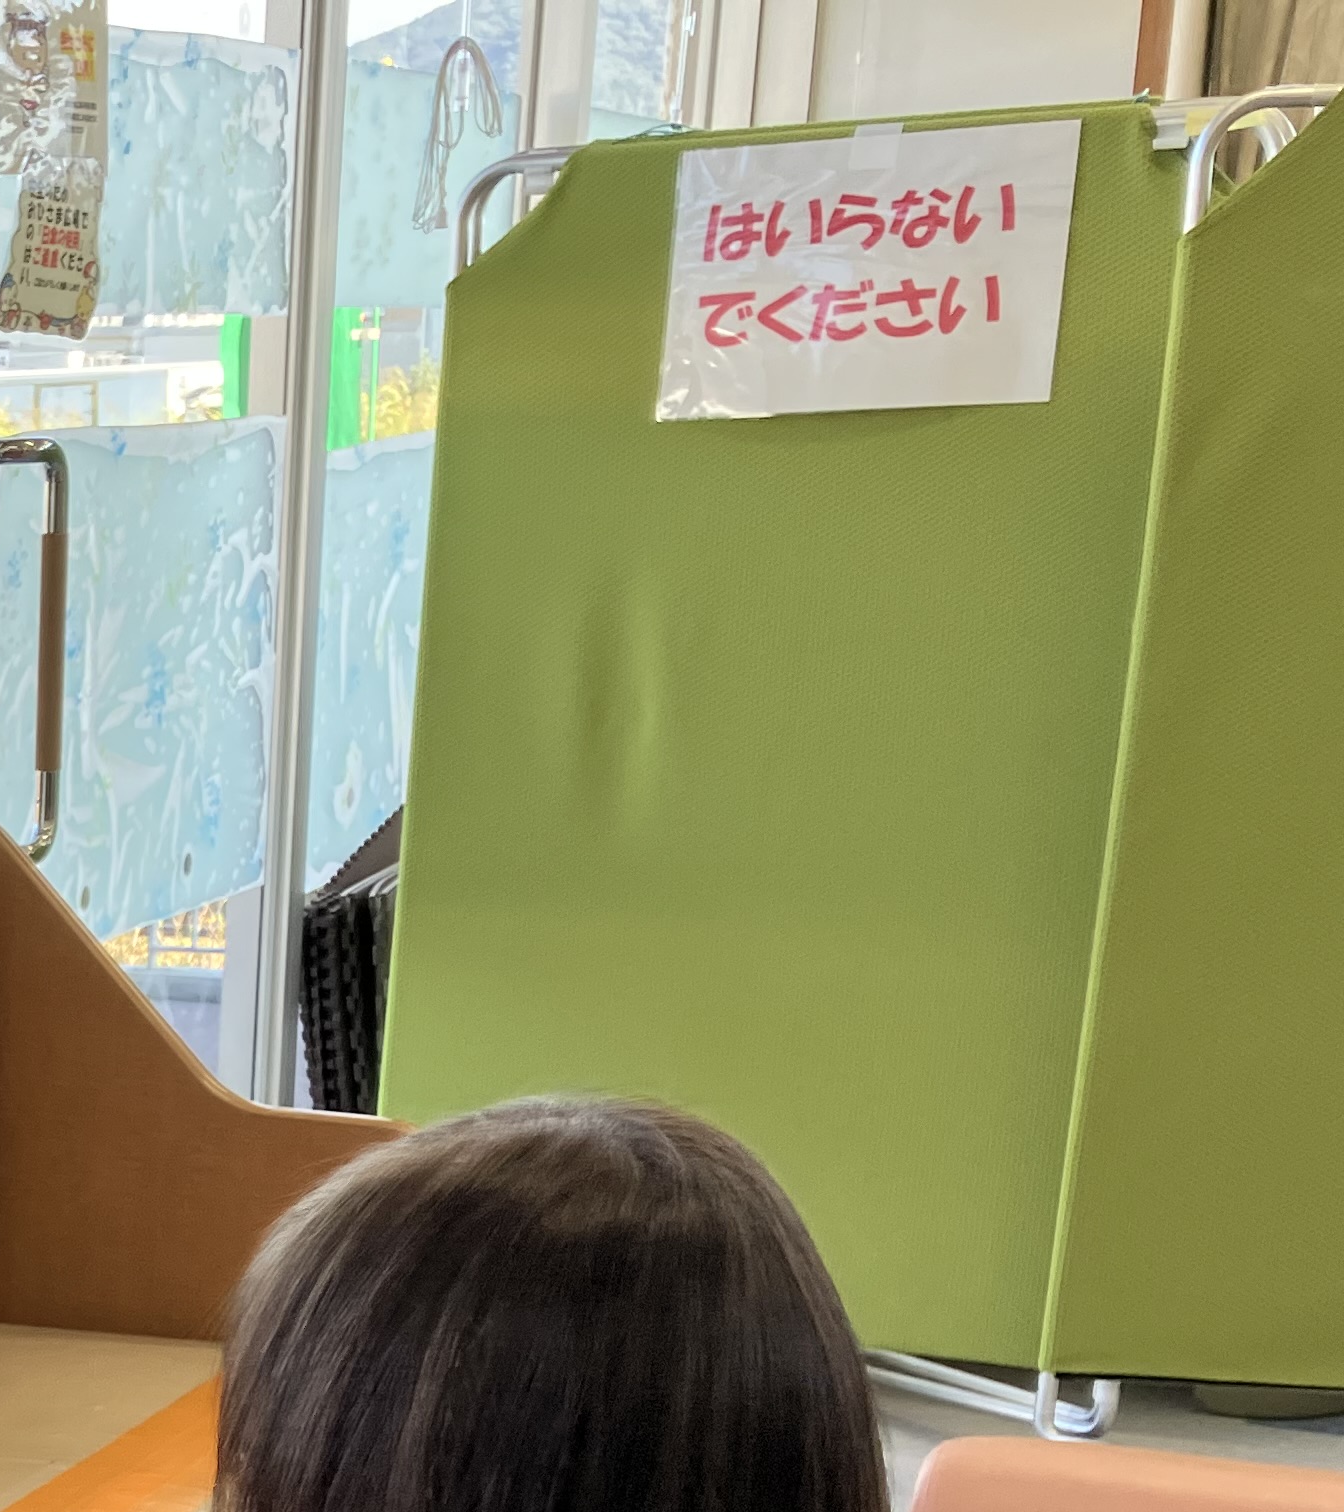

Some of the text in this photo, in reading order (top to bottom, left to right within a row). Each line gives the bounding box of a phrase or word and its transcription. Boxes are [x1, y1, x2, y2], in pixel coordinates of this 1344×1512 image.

[702, 182, 1016, 262] はいらない
[698, 275, 1001, 348] でください
